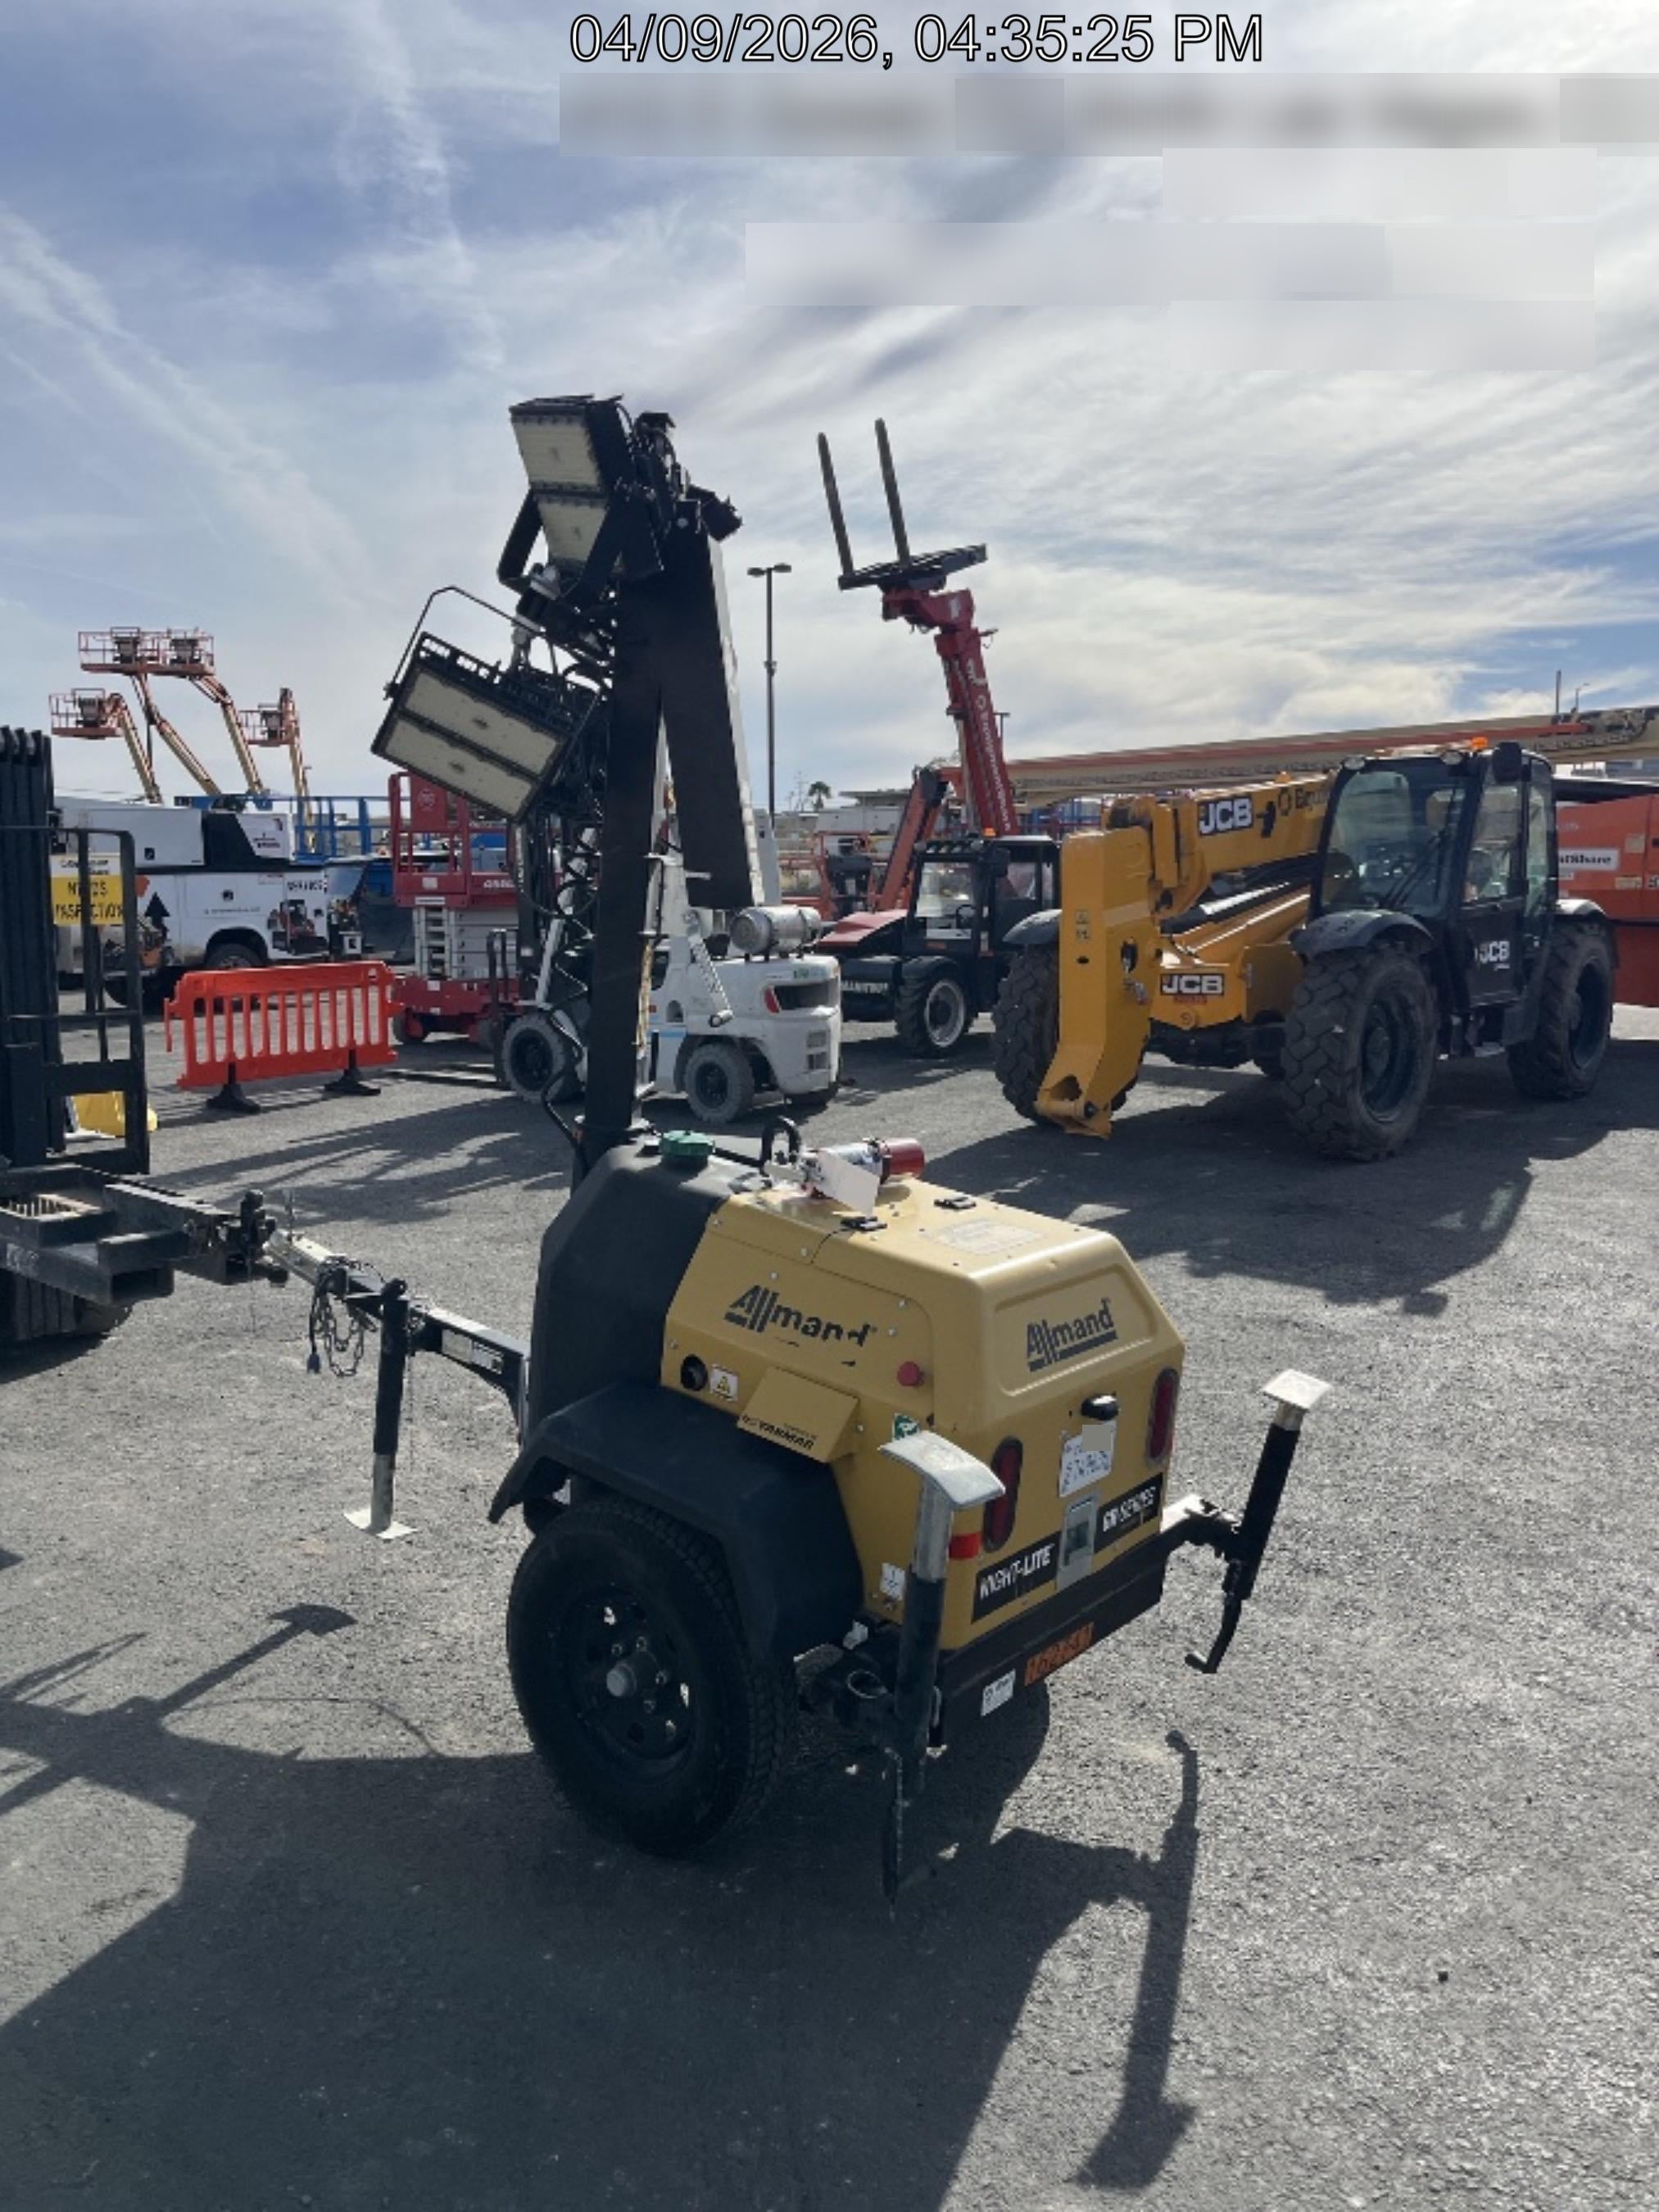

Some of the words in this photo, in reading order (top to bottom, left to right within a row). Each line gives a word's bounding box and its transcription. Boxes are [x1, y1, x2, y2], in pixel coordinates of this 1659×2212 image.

[1199, 798, 1253, 835] JCB
[1480, 941, 1510, 963] JCB
[1162, 975, 1222, 994] JCB
[724, 1285, 873, 1348] Allmand
[1027, 1298, 1115, 1367] Allmand
[759, 1420, 814, 1450] YANMAR
